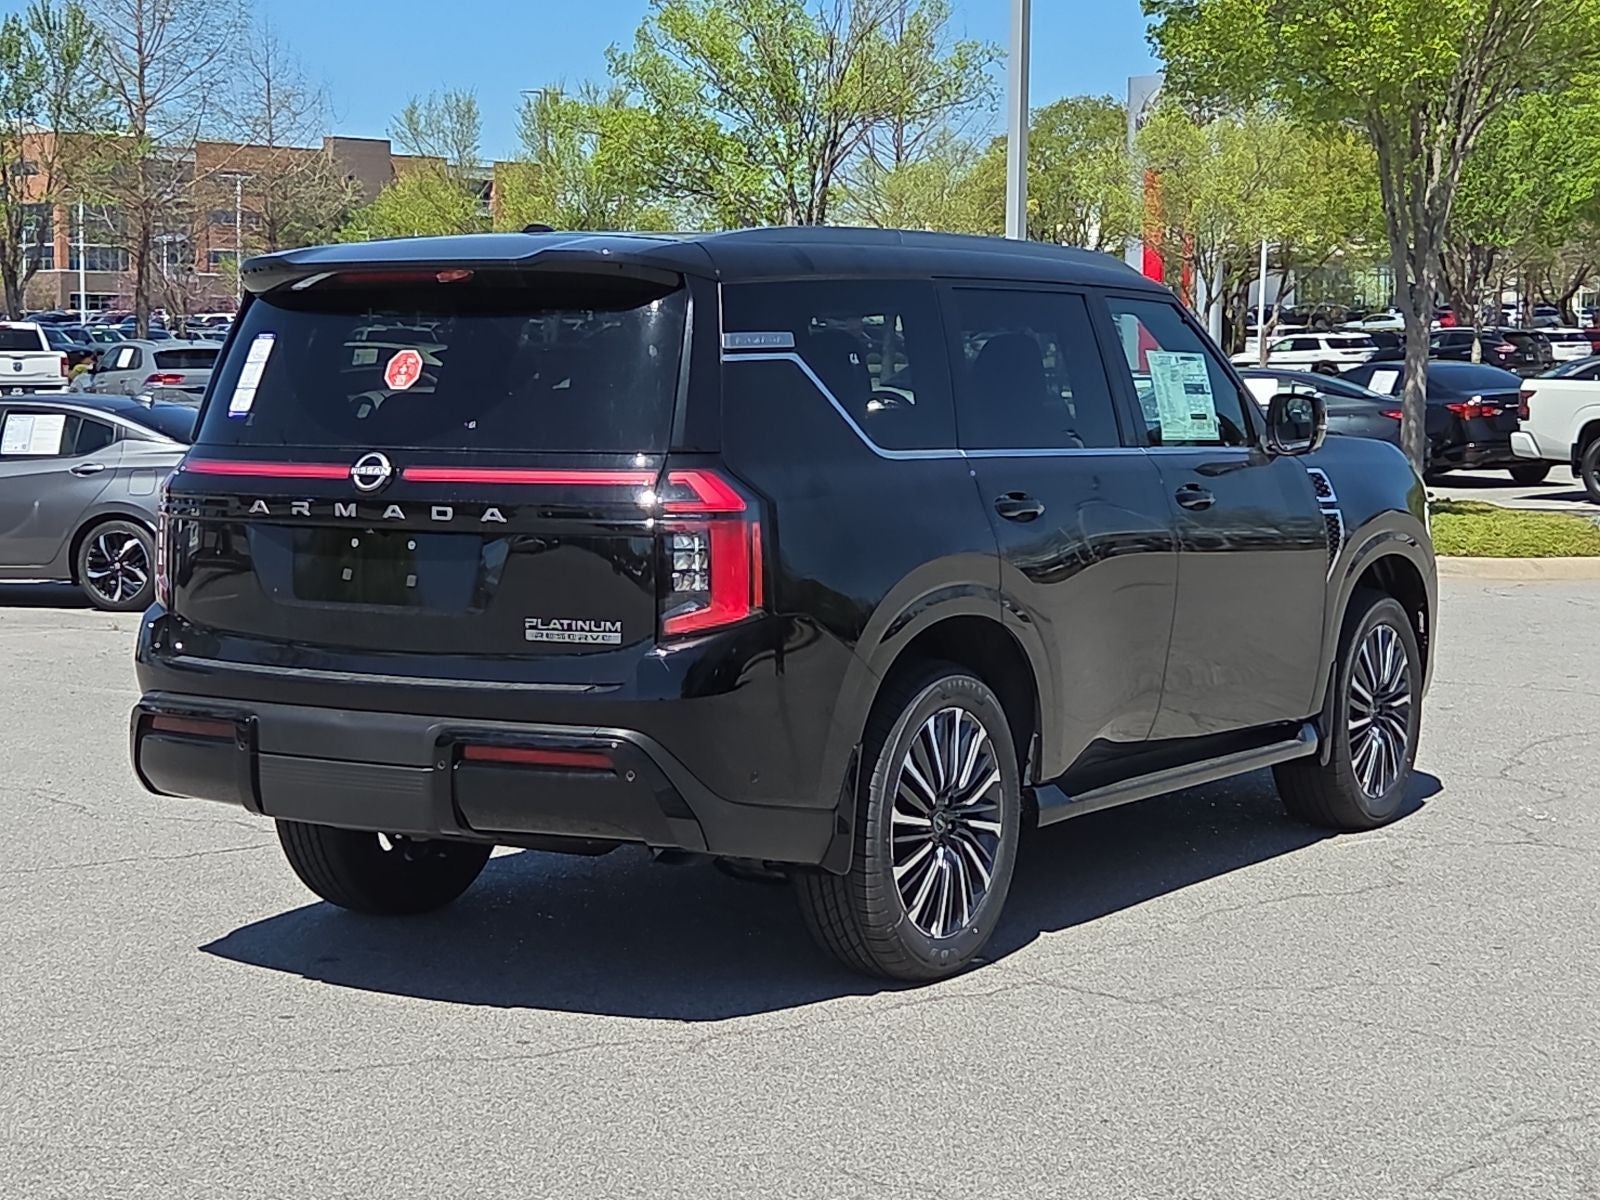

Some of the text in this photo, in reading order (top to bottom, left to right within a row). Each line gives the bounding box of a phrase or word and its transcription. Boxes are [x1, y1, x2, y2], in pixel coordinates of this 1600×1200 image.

[351, 466, 392, 477] NISSAN
[248, 499, 508, 523] ARMADA
[524, 618, 622, 632] PLATINUM
